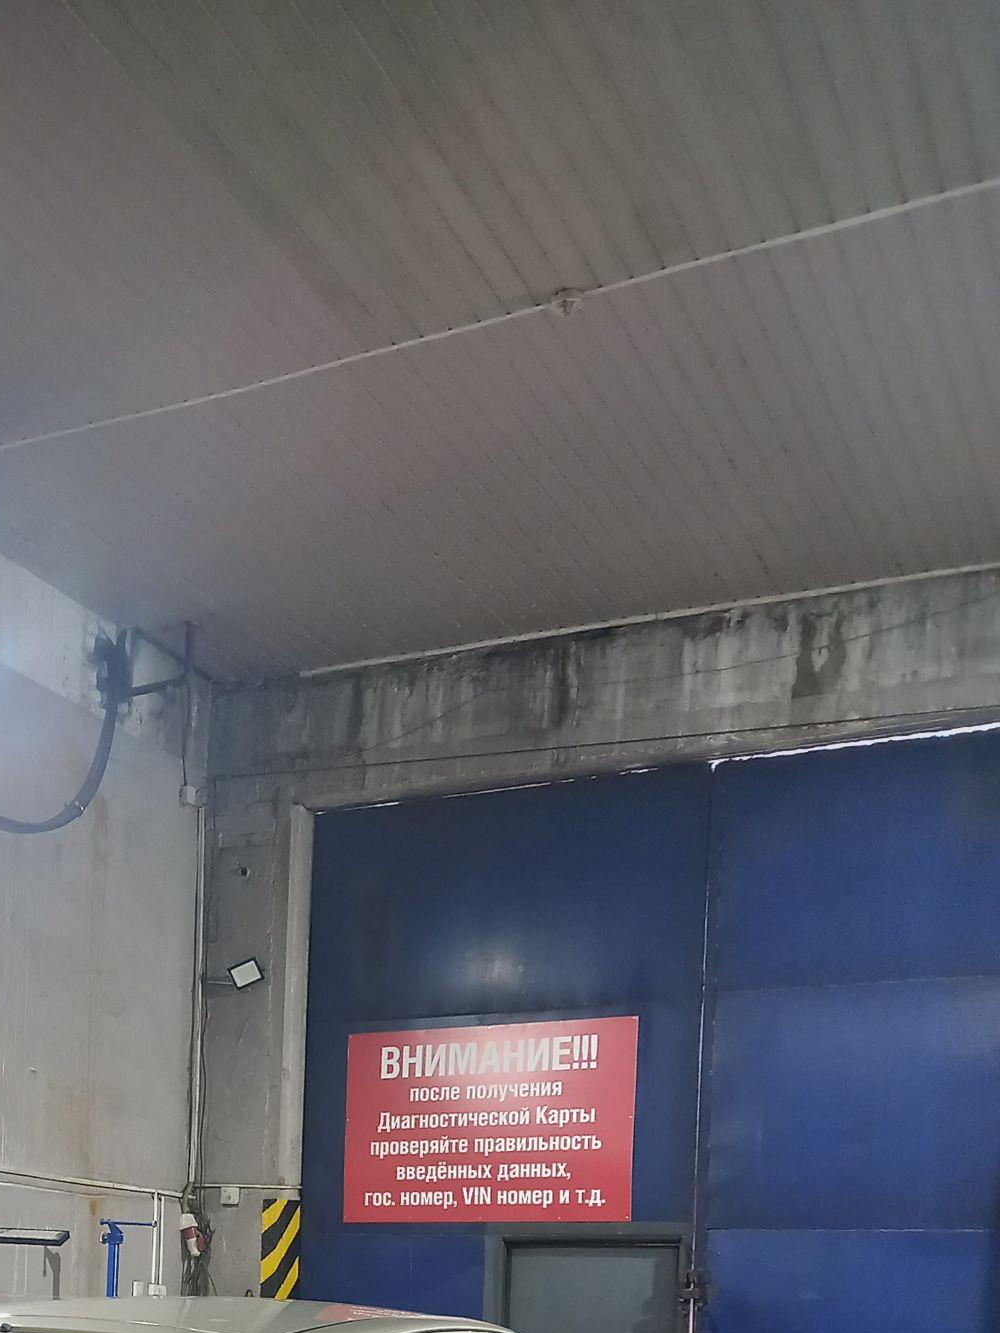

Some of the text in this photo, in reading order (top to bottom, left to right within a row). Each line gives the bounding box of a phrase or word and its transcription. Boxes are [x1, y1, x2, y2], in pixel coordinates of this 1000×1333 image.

[380, 1034, 598, 1080] ВНИМАНИЕ!!!
[409, 1081, 563, 1102] после получения
[377, 1106, 596, 1134] Диагностической Карты
[370, 1133, 602, 1158] проверяйте правильность
[396, 1162, 571, 1182] введённых данных,
[364, 1187, 606, 1208] гос. номер, VIN номер и т.д.
